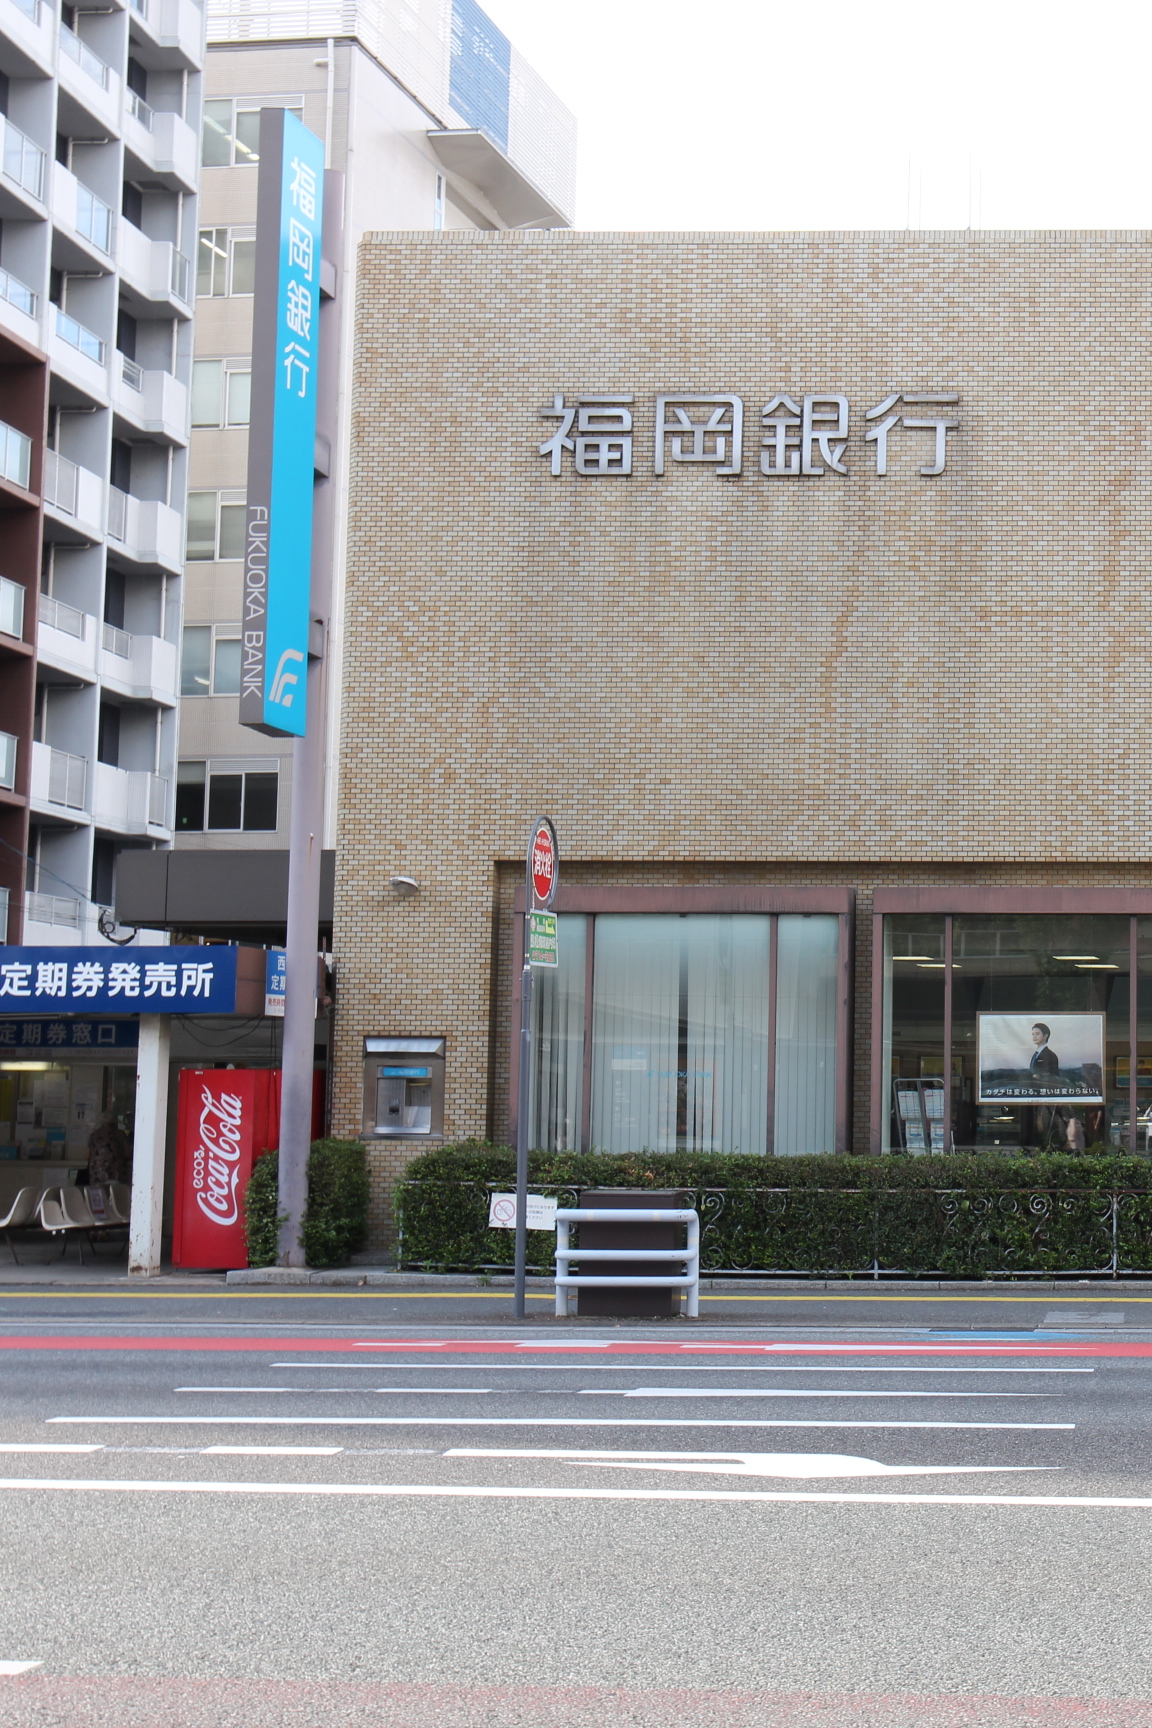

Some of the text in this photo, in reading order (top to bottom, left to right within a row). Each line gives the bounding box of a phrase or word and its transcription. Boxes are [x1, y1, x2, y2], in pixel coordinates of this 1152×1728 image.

[284, 156, 316, 398] 福岡銀行
[538, 393, 960, 477] 福岡銀行
[242, 505, 268, 699] FUKUOKA BANK
[534, 849, 552, 878] 消火栓
[0, 961, 214, 998] 定期券発売所
[0, 1022, 116, 1045] 定期券窓口
[196, 1084, 242, 1226] Coca-Cola
